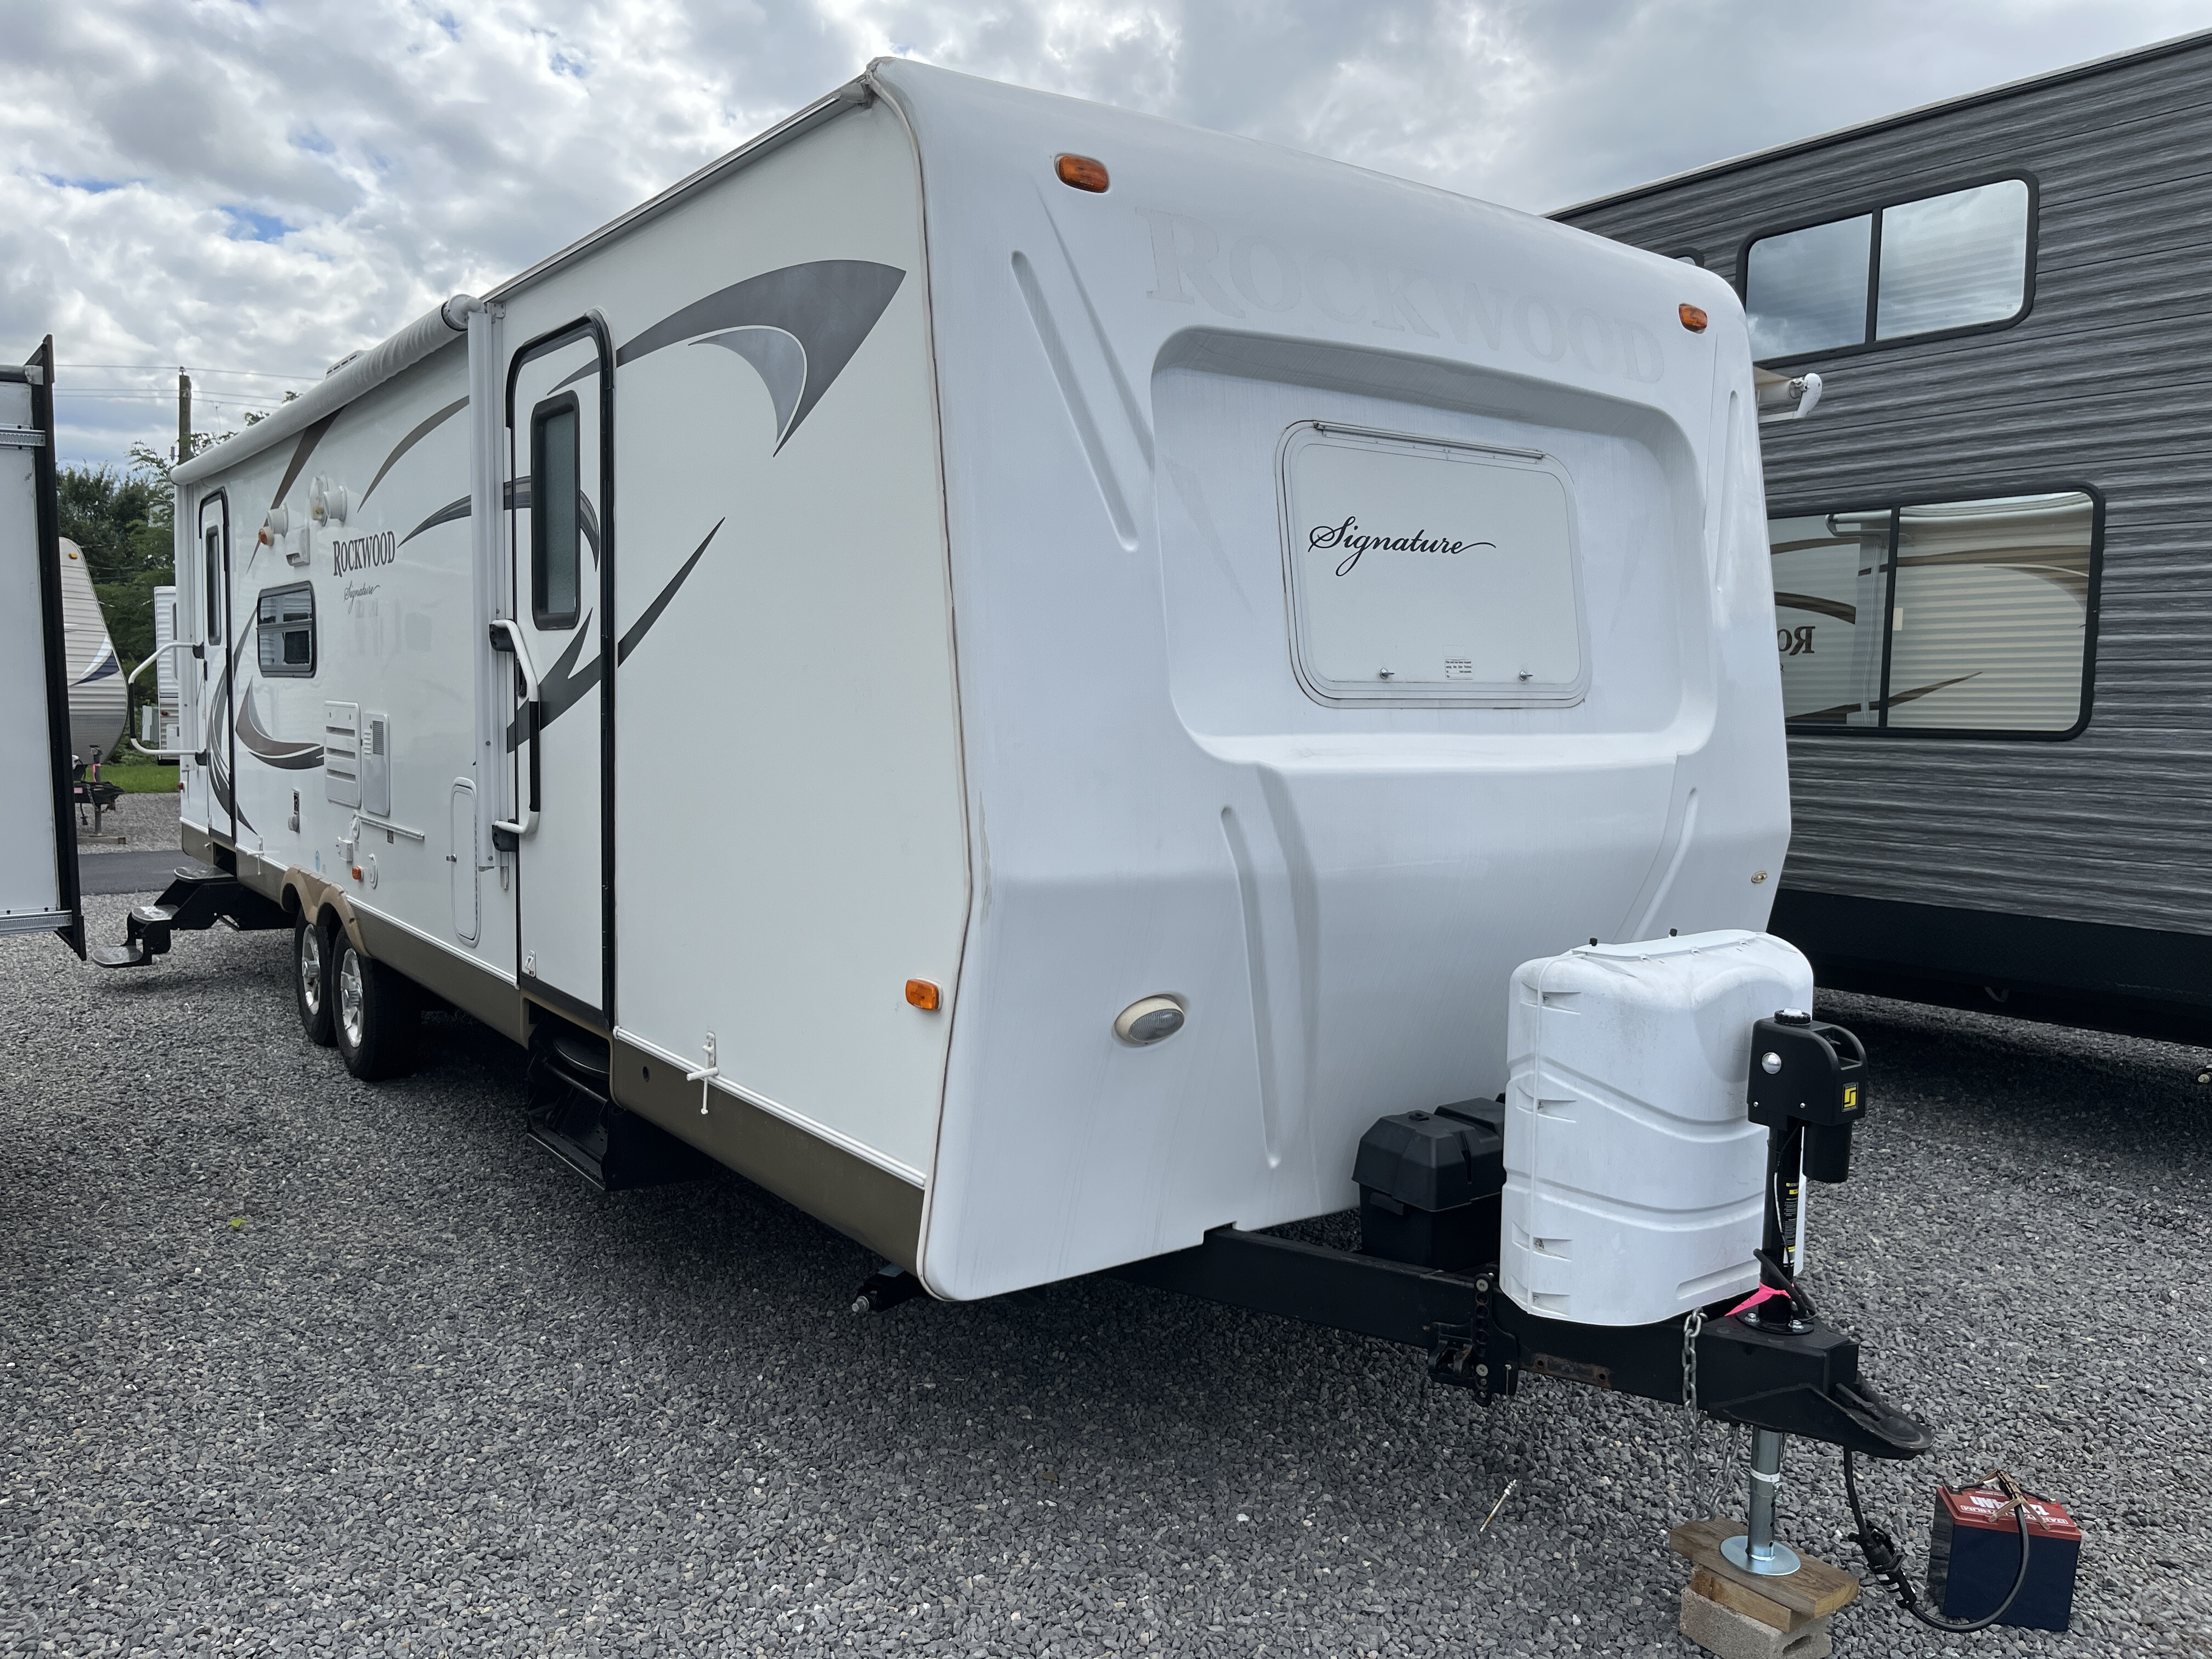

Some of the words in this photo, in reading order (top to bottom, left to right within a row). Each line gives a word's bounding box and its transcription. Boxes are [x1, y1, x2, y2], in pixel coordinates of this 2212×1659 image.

[333, 531, 396, 577] ROCKWOOD
[1308, 516, 1497, 577] Signature
[344, 580, 381, 614] Signature
